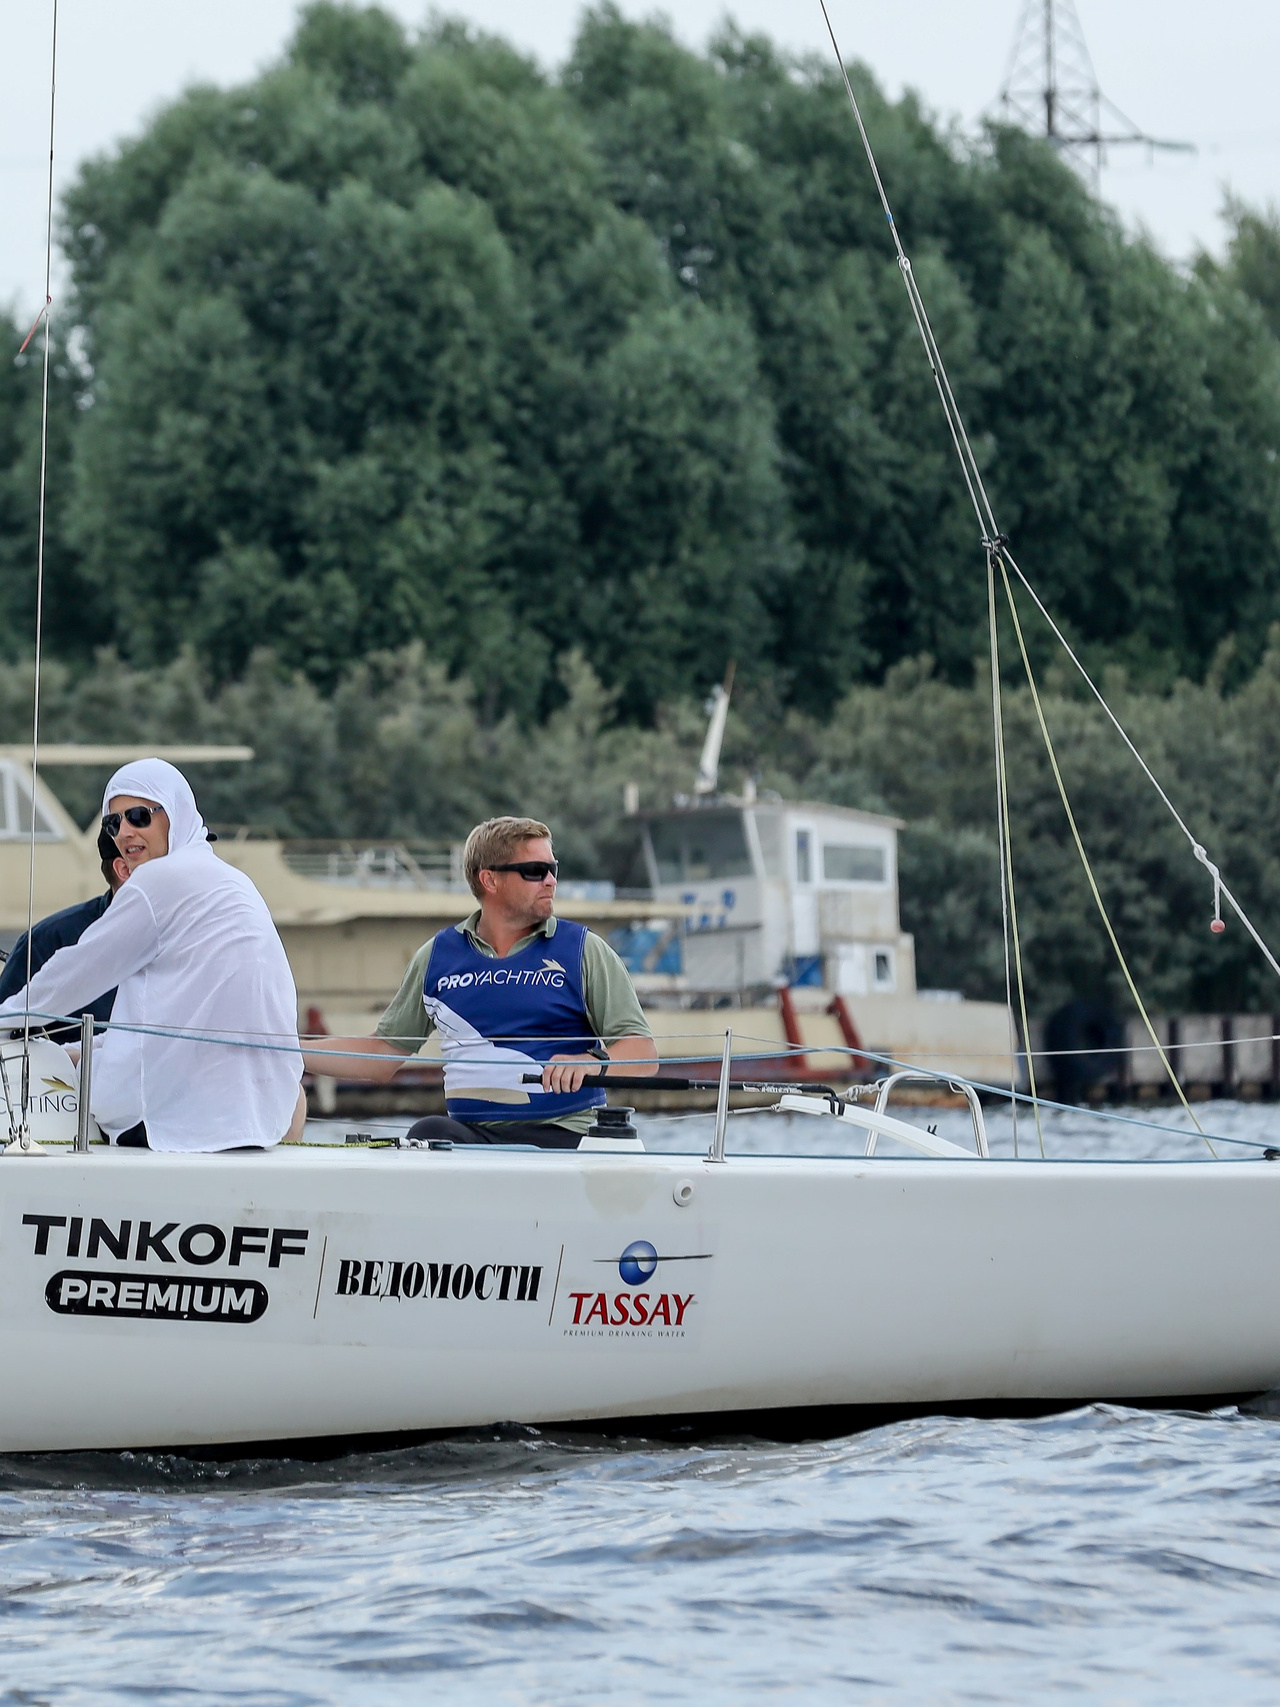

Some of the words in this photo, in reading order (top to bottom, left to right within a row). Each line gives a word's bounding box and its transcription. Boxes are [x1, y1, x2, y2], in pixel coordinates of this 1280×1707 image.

[438, 969, 565, 992] PROYACHTING
[22, 1214, 309, 1268] TINKOFF
[58, 1279, 255, 1315] PREMIUM
[335, 1259, 543, 1302] ВЕДОМОСТИ
[568, 1292, 695, 1326] TASSAY
[563, 1329, 605, 1338] PREMIUM
[608, 1330, 654, 1339] DRINKING
[657, 1330, 687, 1339] WATER
